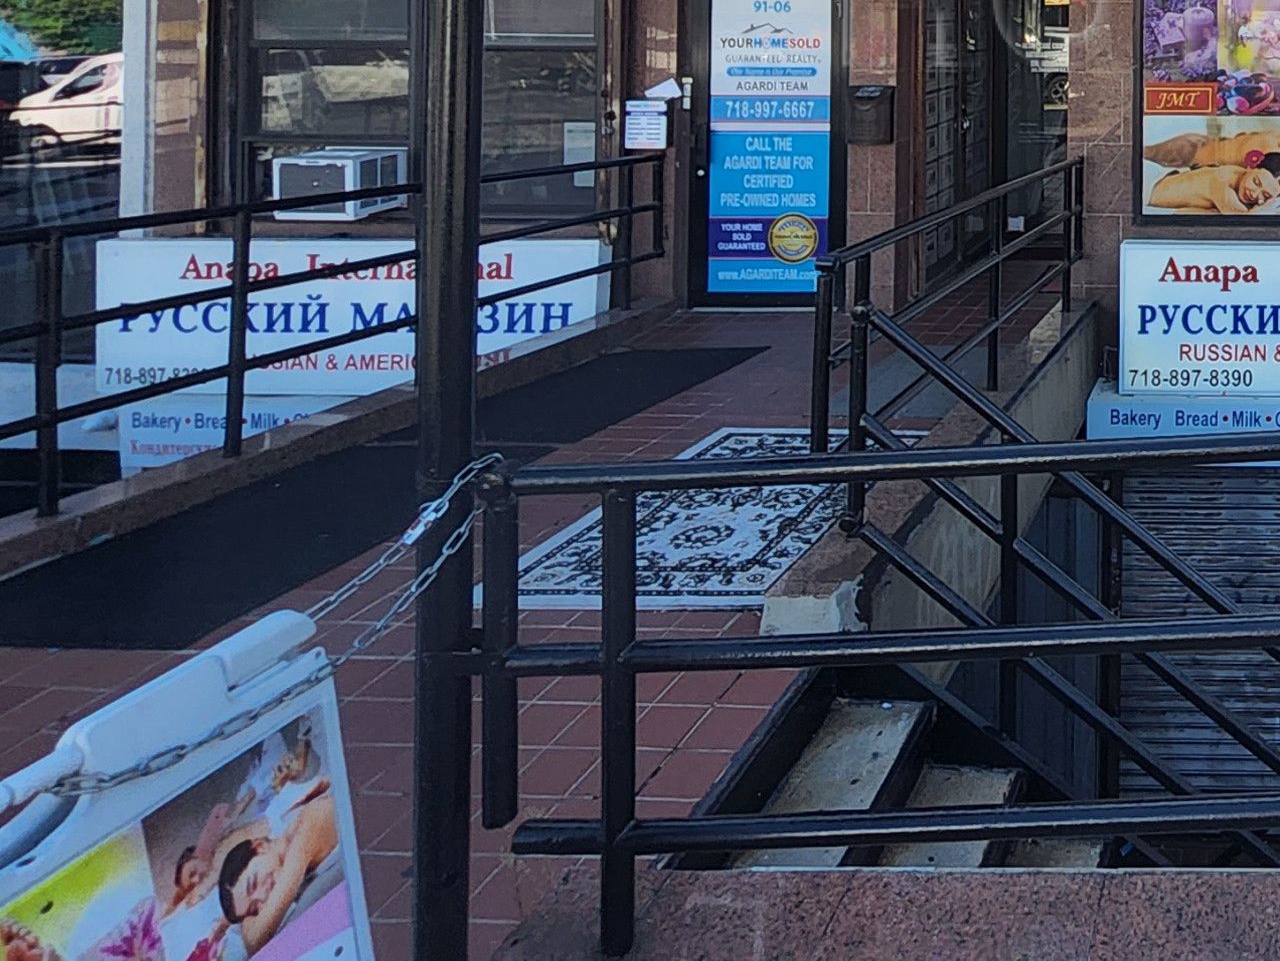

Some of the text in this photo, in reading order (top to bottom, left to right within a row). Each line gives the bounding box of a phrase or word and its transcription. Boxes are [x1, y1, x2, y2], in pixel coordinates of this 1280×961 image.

[753, 0, 791, 13] 91-06
[736, 81, 808, 92] AGARDI TEAM
[1155, 90, 1202, 110] JMT
[725, 101, 815, 119] 718-997-6667
[745, 136, 792, 151] CALL THE
[724, 156, 813, 170] AGARDI FOR
[743, 174, 794, 189] CERTIFIED
[720, 193, 816, 207] PRE-OWNED HOMES
[1159, 256, 1259, 292] Anapa
[1178, 345, 1267, 363] RUSSIAN
[1128, 368, 1254, 389] 718-897-8390
[131, 411, 188, 433] Bakery
[250, 411, 279, 430] Milk
[1110, 408, 1162, 429] Bakery
[1174, 410, 1219, 427] Bread
[1232, 409, 1262, 428] Milk
